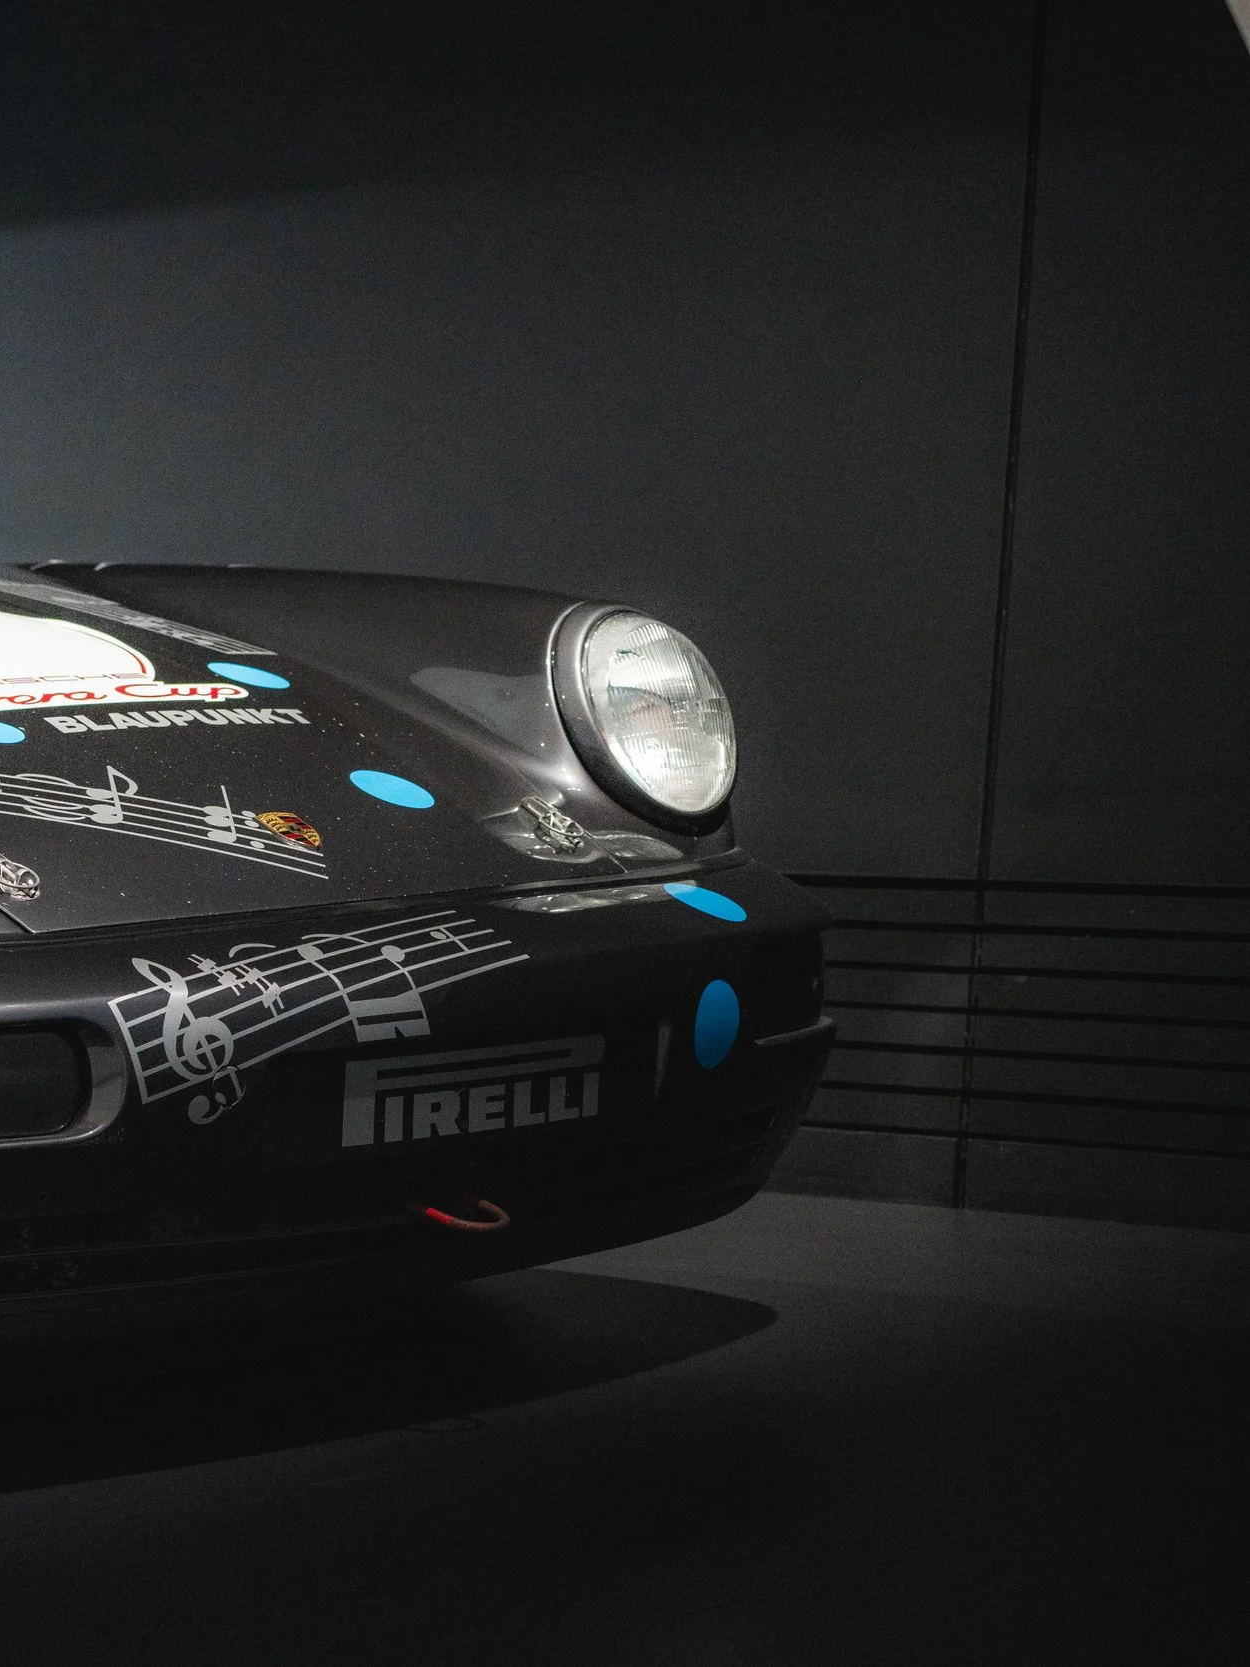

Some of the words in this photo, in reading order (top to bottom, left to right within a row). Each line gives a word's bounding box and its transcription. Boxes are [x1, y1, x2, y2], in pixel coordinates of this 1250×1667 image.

[115, 682, 241, 702] Cup
[43, 708, 312, 733] BLAUPUNKT
[341, 1033, 606, 1147] PIRELLI
